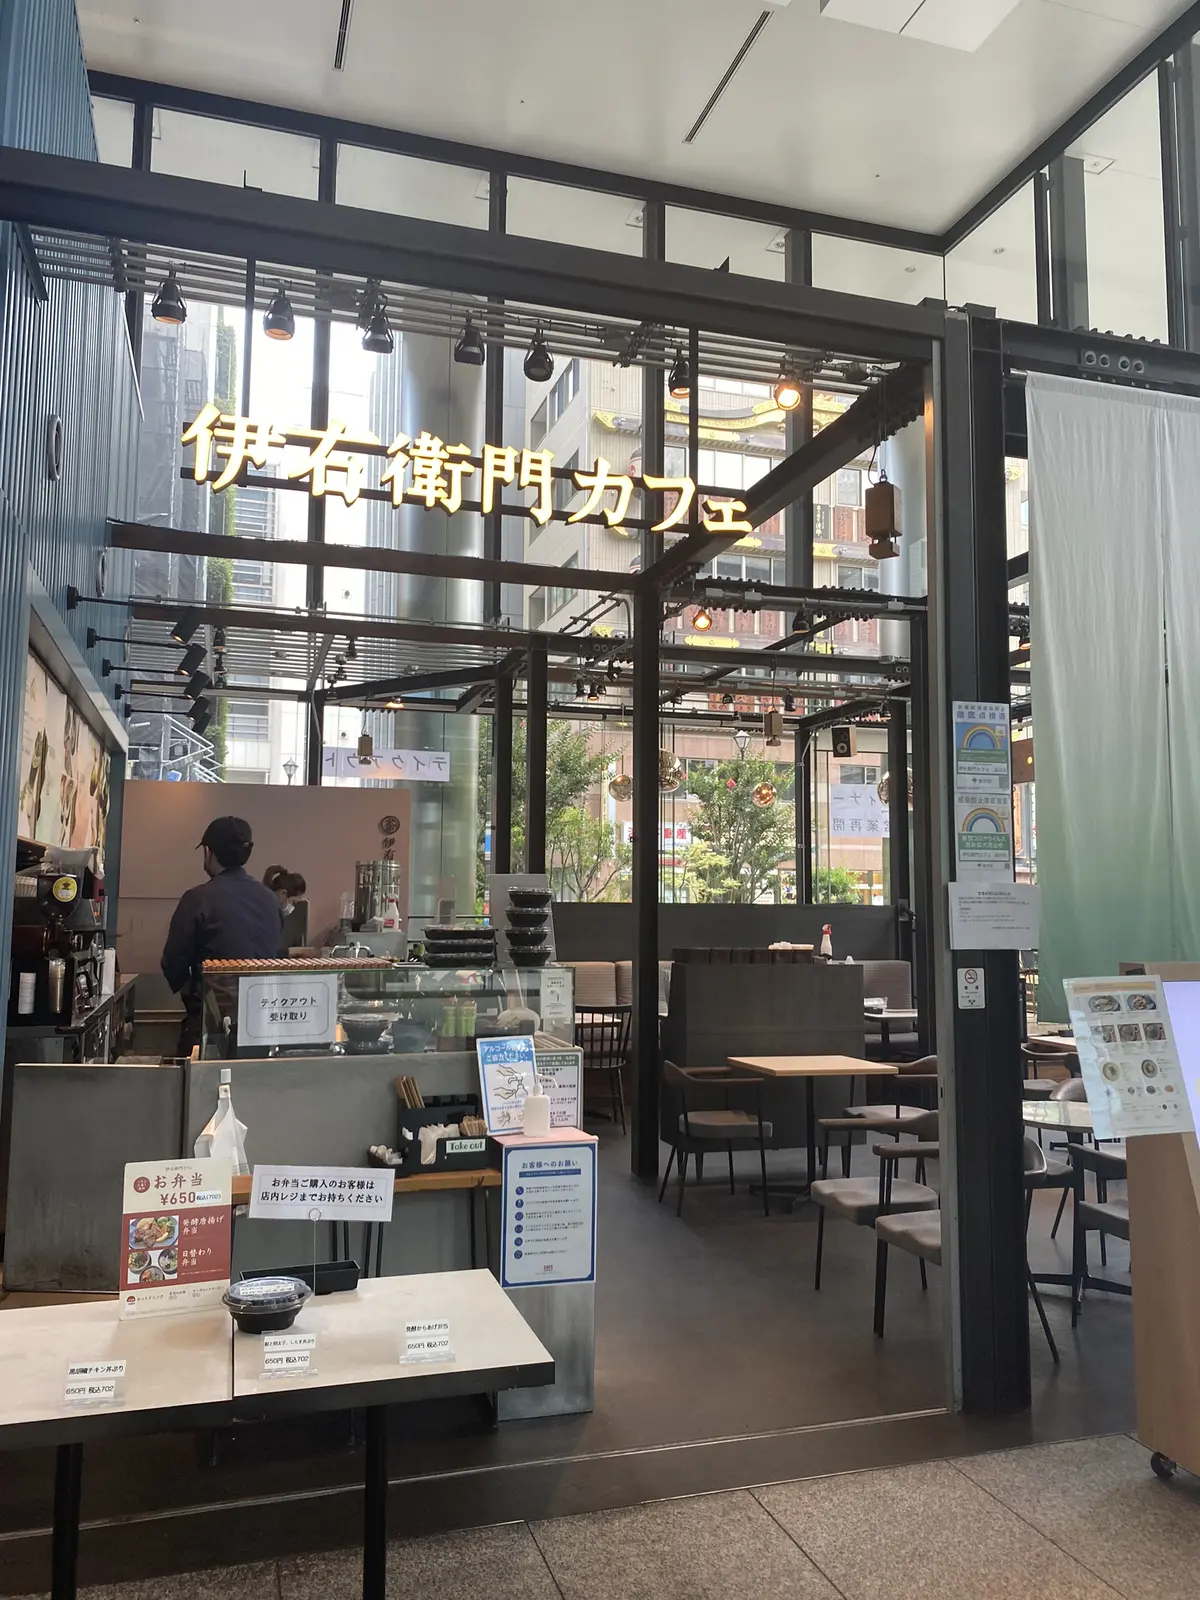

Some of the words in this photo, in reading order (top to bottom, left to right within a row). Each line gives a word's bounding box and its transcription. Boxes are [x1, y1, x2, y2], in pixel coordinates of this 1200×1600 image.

[180, 401, 754, 535] 伊右衛門カフェ
[261, 996, 317, 1007] テイクアウト
[270, 1011, 308, 1022] 受け取り
[522, 1159, 579, 1169] お客様へのお願い
[154, 1172, 203, 1189] お弁当
[271, 1178, 375, 1190] お弁当ご購入のお客様は
[160, 1191, 196, 1206] ¥650
[260, 1191, 383, 1203] 店内レジまでお持ちください
[182, 1247, 212, 1258] 日替わり
[264, 1357, 284, 1365] 650円
[65, 1387, 86, 1395] 650円
